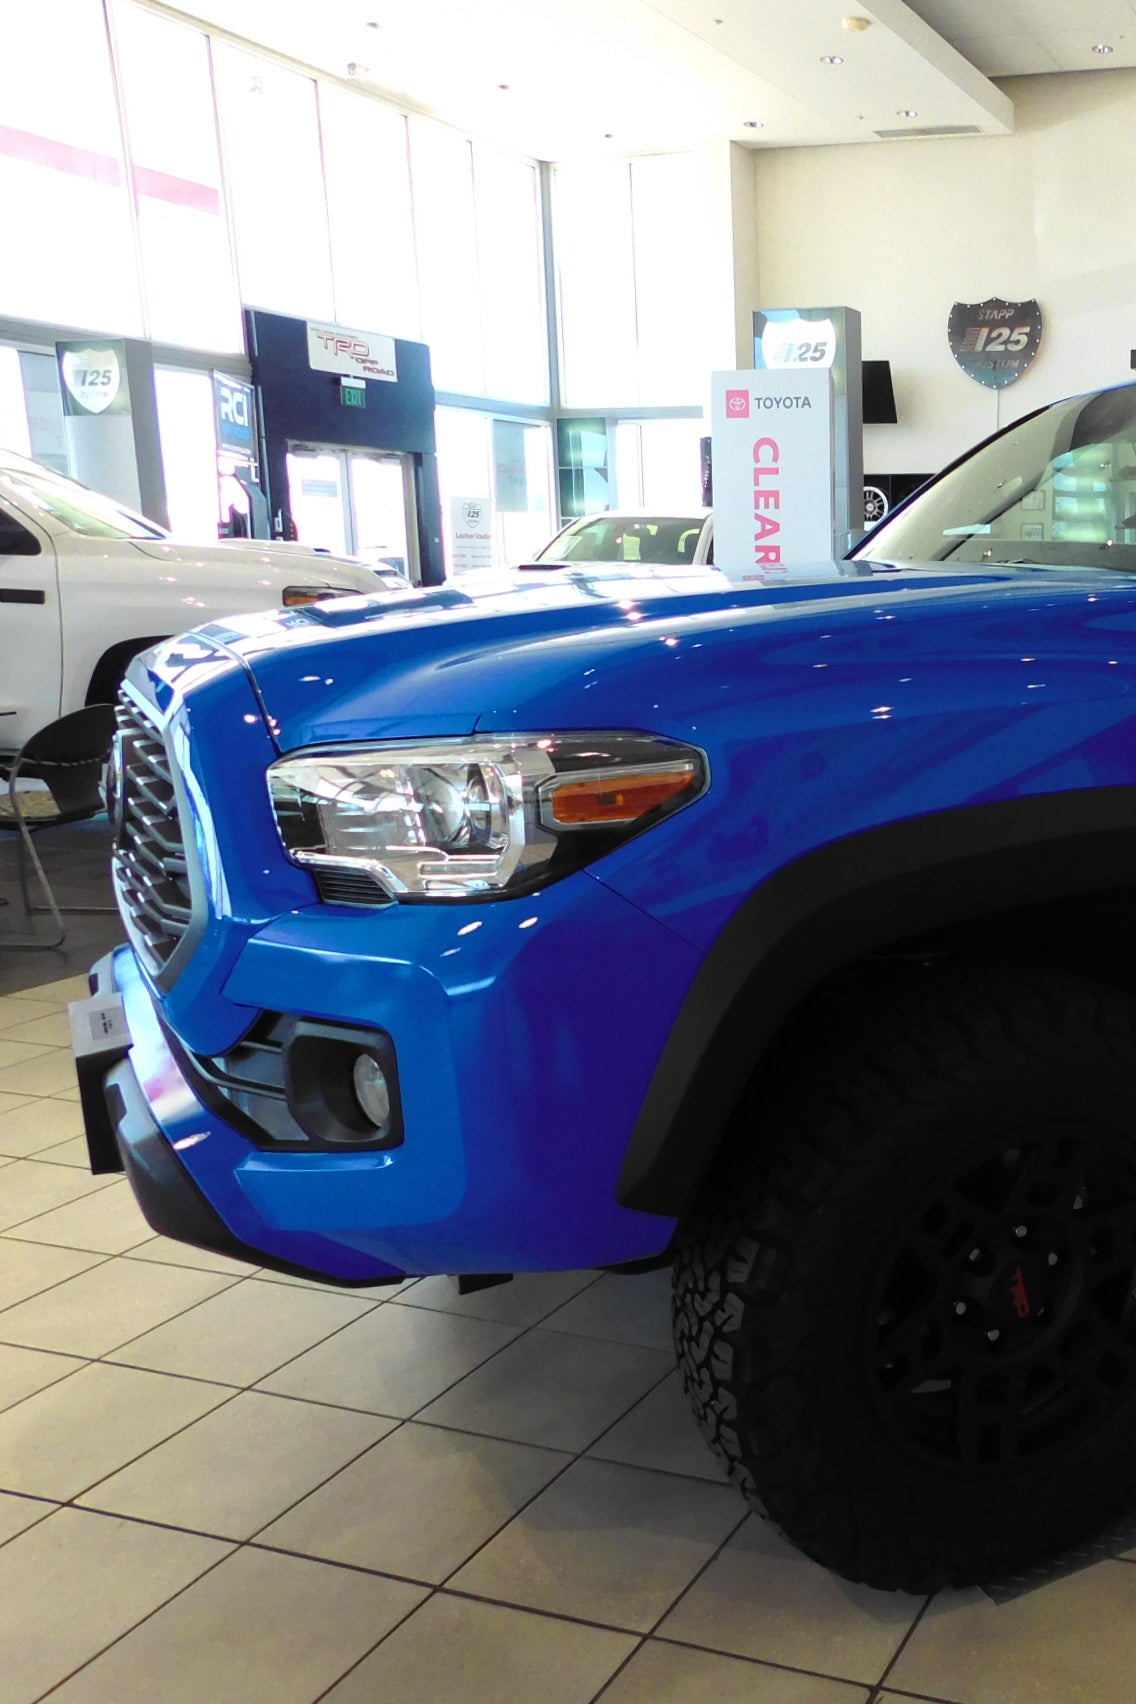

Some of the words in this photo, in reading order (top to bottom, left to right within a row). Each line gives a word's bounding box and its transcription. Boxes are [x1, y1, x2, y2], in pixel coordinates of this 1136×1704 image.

[976, 308, 1015, 321] STAPP
[317, 333, 369, 357] TRD
[976, 358, 1020, 370] USTOM
[362, 366, 395, 377] ROAD
[754, 395, 813, 411] TOYOTA
